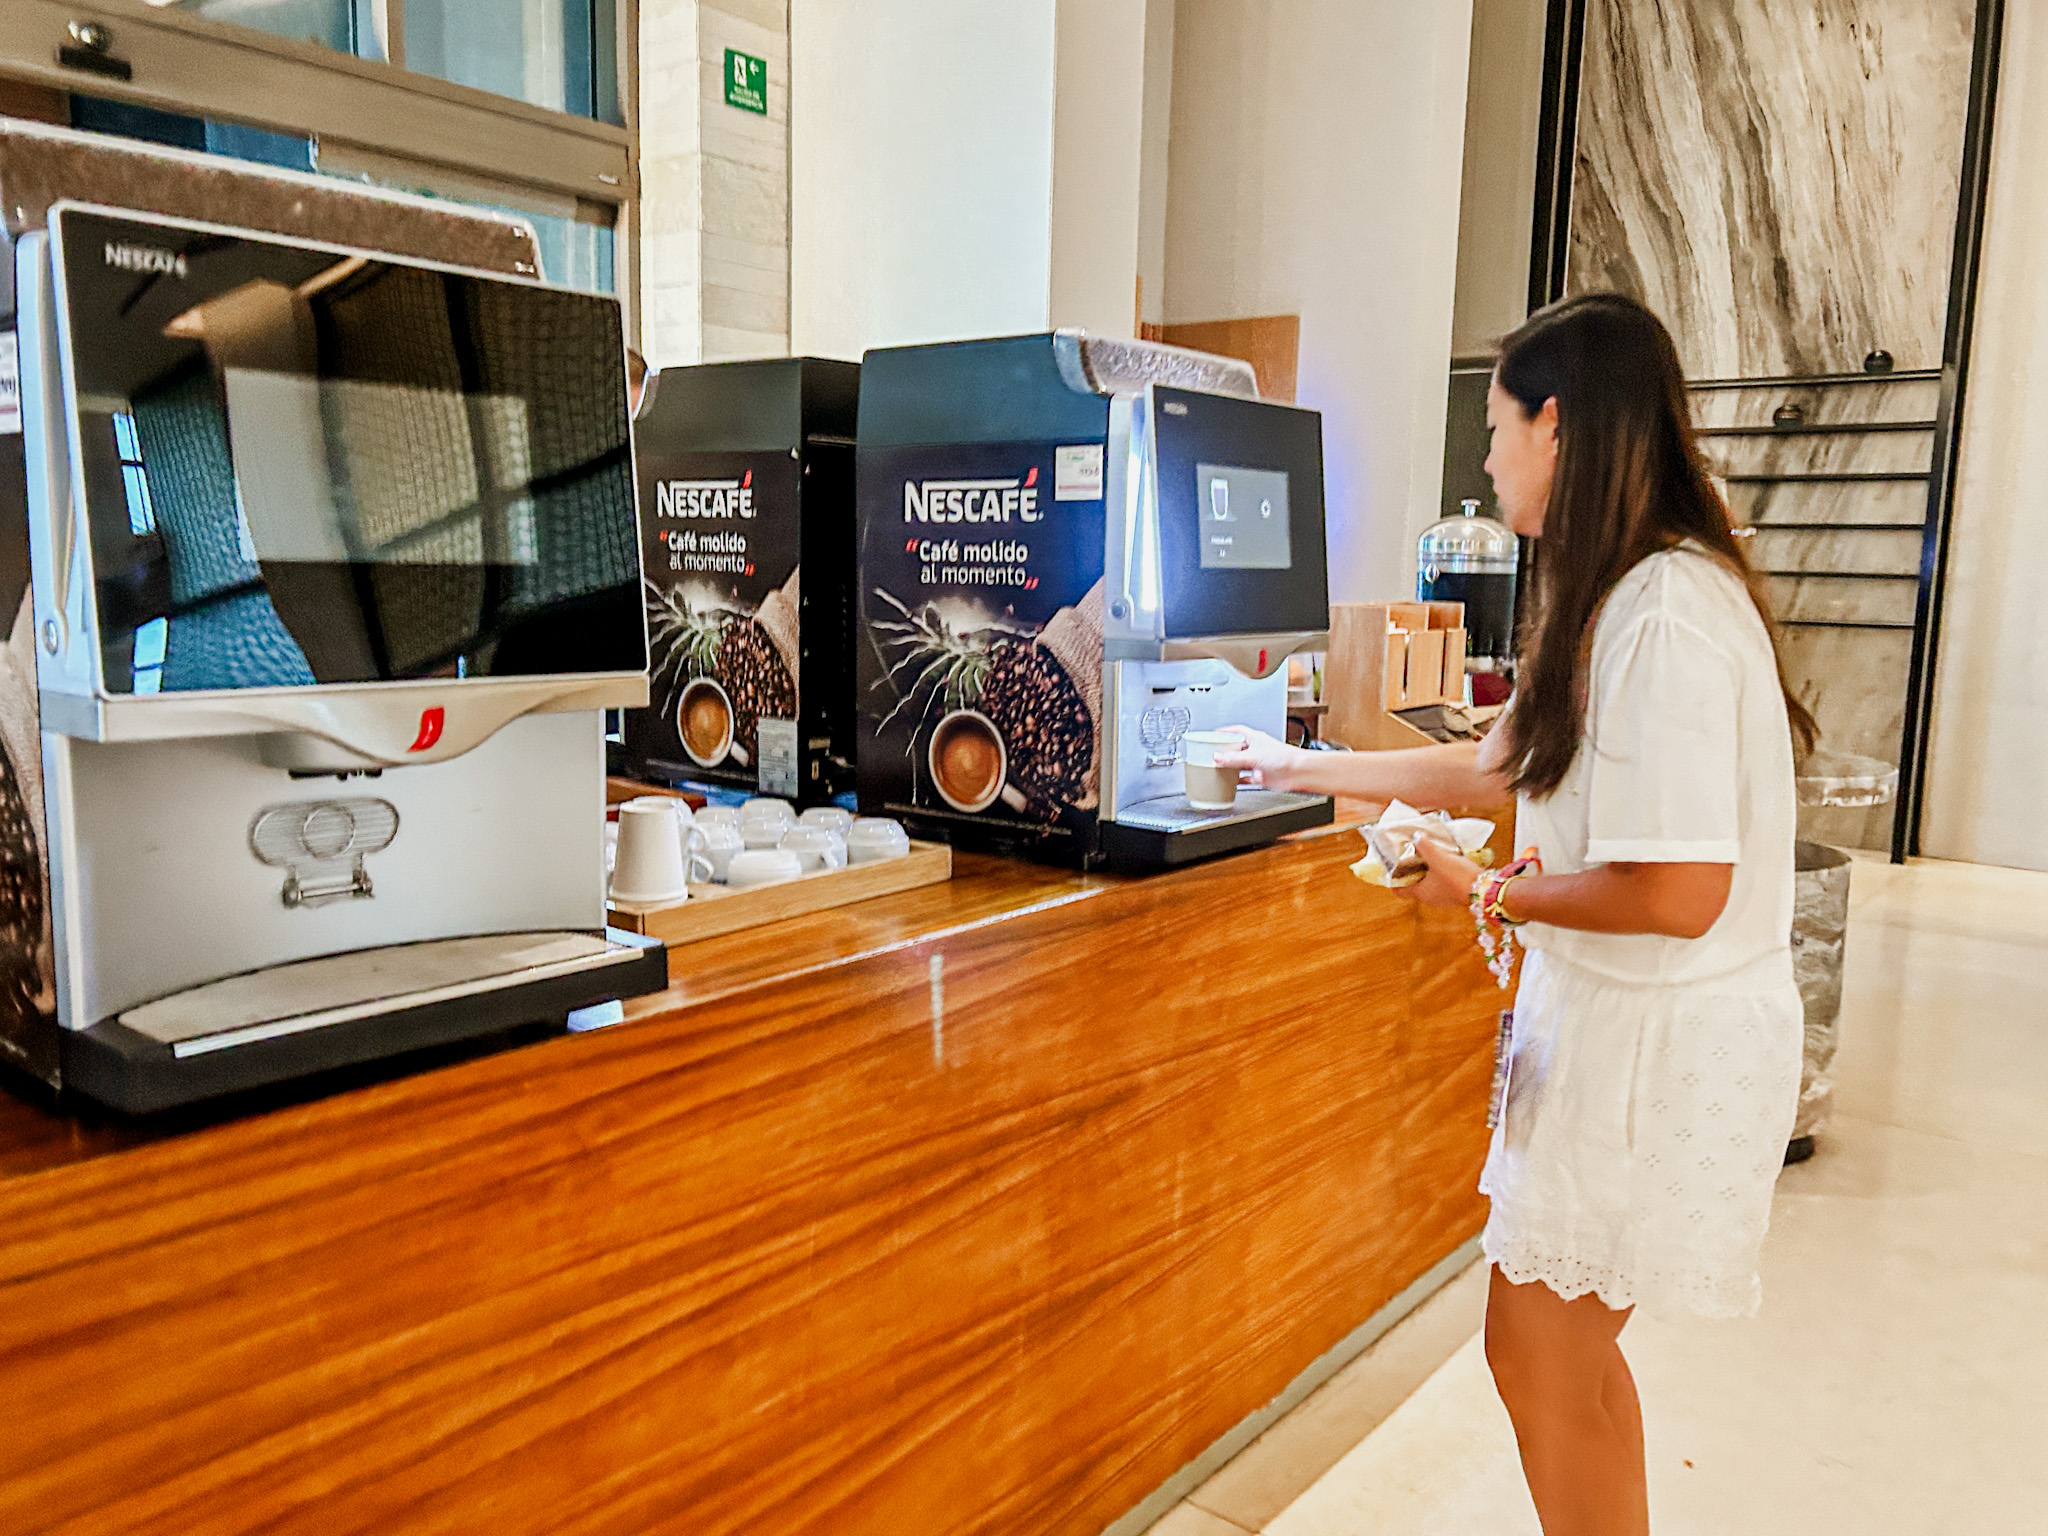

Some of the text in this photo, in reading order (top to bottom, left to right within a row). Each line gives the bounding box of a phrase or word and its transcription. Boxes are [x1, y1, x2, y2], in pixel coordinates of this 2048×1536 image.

[656, 468, 754, 519] NESCAFÉ
[904, 466, 1040, 524] NESCAFÉ
[700, 530, 747, 554] molido
[963, 539, 1029, 564] molido
[669, 551, 682, 571] al
[920, 563, 937, 585] al
